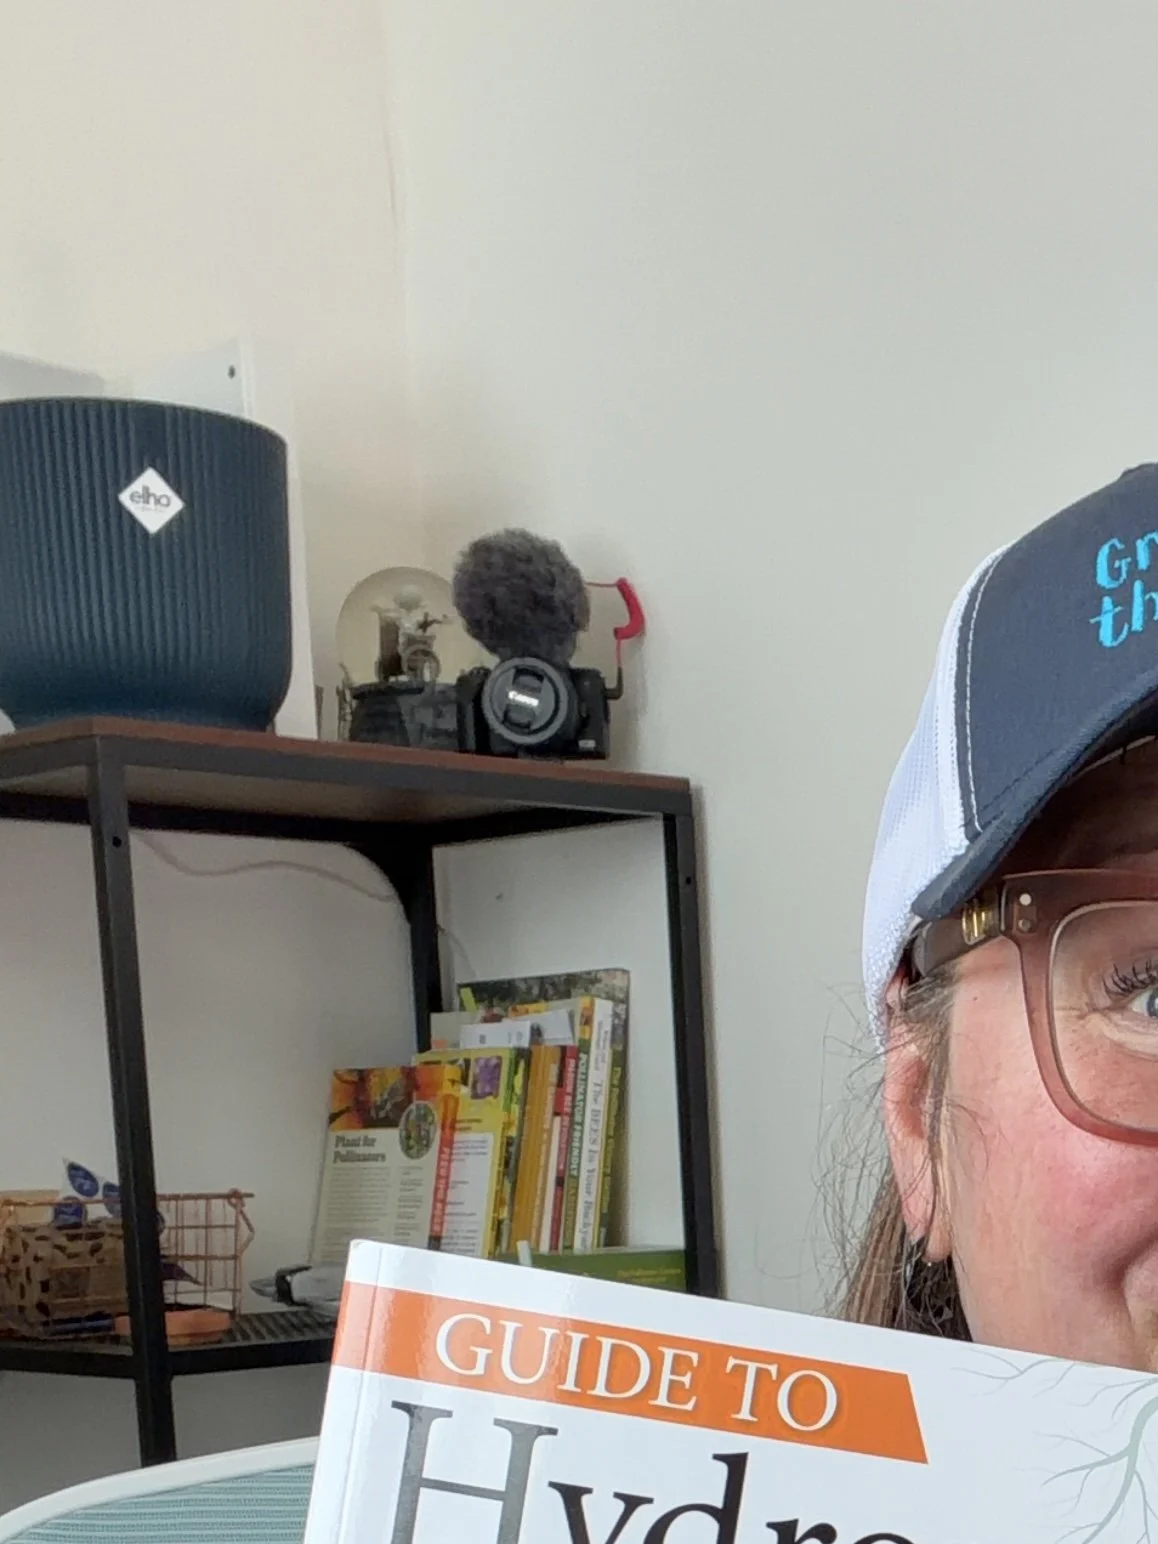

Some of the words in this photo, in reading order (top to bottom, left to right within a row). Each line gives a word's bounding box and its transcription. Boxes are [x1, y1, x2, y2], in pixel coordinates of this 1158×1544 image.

[129, 485, 171, 508] elho
[574, 1053, 588, 1122] POLLINATOR
[570, 1124, 583, 1176] FRIENDLY
[589, 1109, 602, 1145] BEES
[436, 1312, 699, 1412] GUIDE
[725, 1353, 838, 1432] TO
